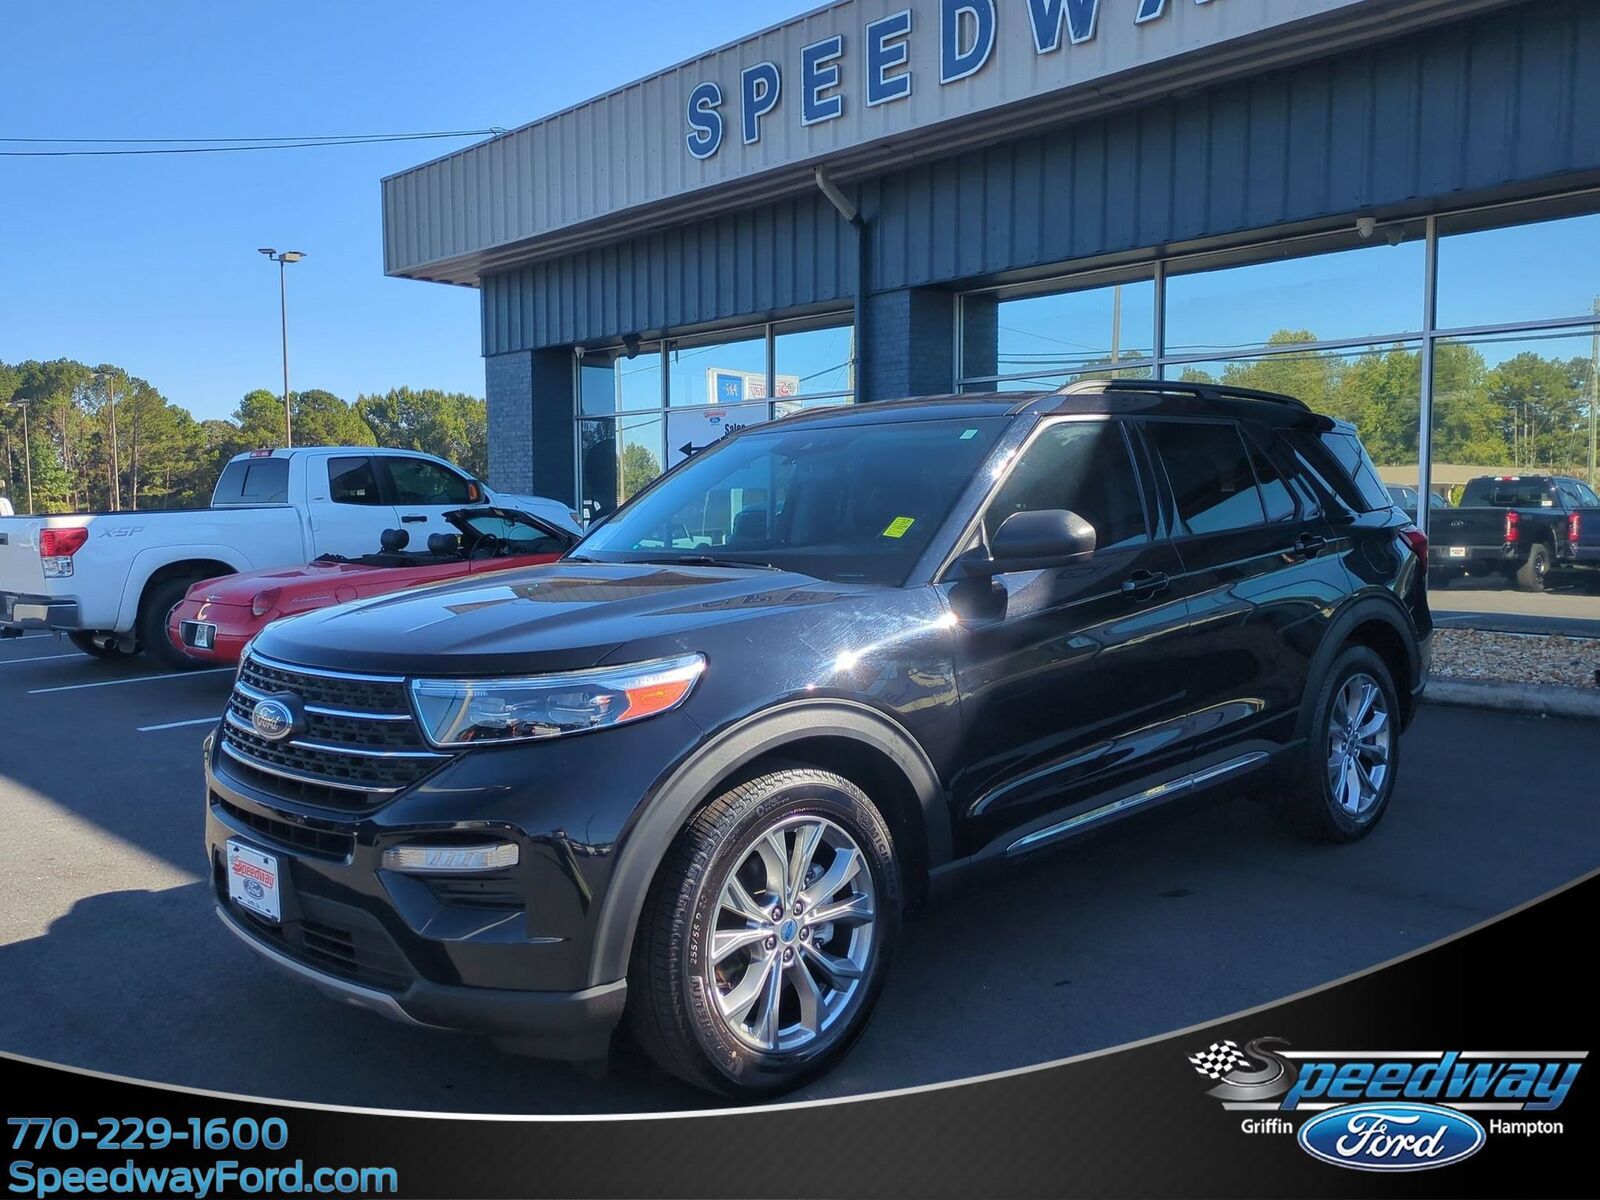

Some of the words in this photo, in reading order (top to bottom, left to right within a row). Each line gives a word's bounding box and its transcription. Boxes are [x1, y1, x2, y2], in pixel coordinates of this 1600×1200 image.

[685, 0, 1206, 160] SPEEDW
[256, 706, 282, 731] Ford
[231, 855, 275, 889] Speedway
[689, 924, 701, 964] 255/55
